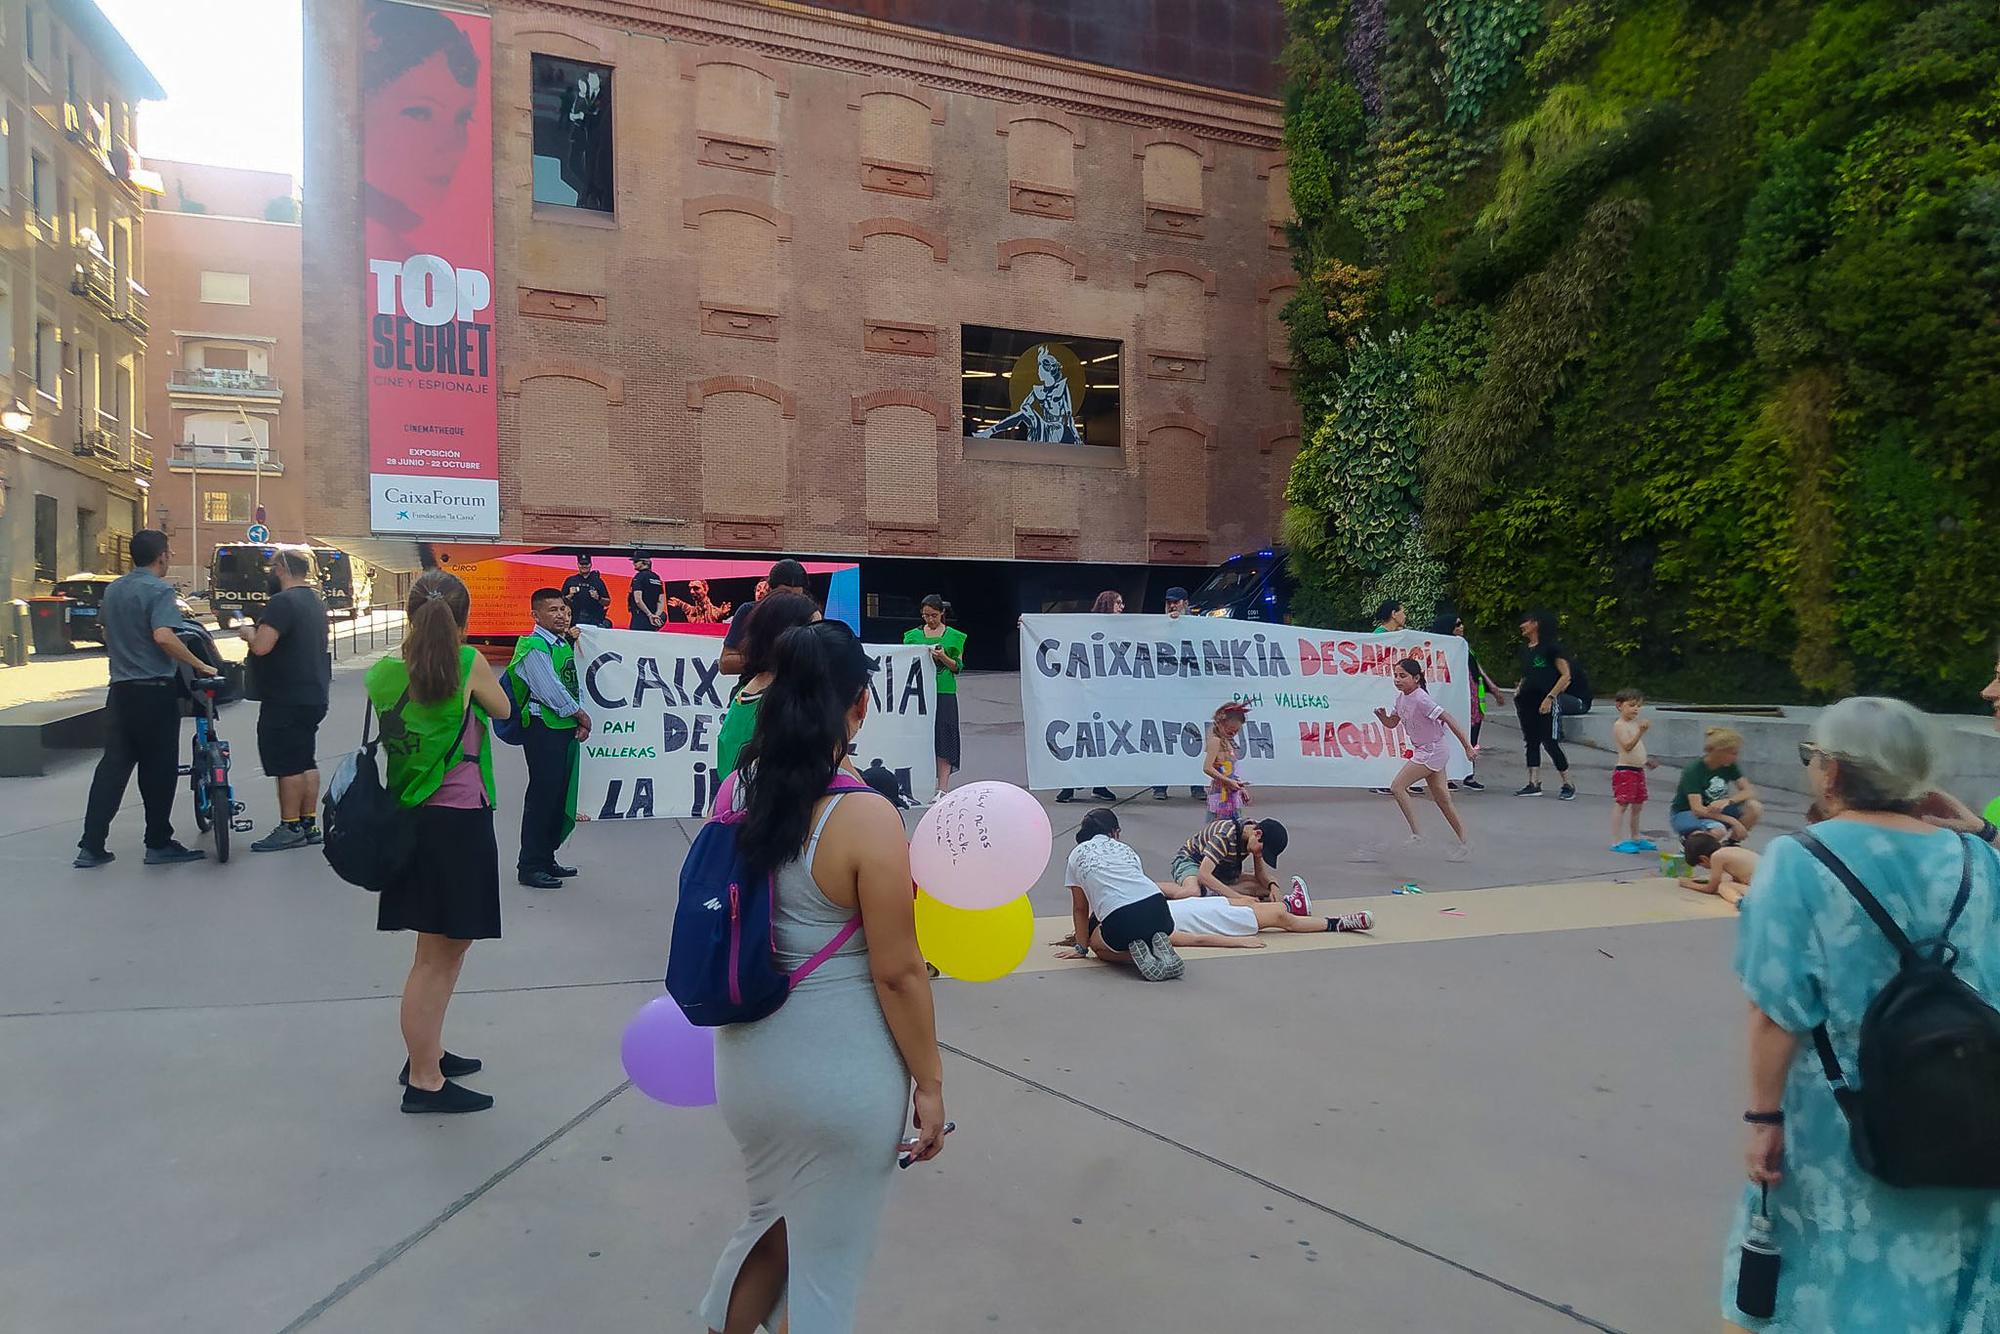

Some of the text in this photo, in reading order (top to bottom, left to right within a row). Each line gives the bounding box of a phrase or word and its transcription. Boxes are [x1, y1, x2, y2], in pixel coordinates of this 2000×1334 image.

[369, 254, 491, 327] TOP
[373, 315, 491, 377] SECRET
[374, 376, 488, 394] CINE Y ESPIONAJE
[409, 448, 461, 458] EXPOSICIÓN
[398, 458, 425, 466] JUNIO
[431, 460, 440, 468] 22
[442, 460, 481, 469] OCTUBRE
[384, 487, 486, 507] CaixaForum
[452, 564, 478, 572] CIRCO
[1233, 691, 1330, 709] PAH VALLEKAS
[602, 720, 636, 734] PAH
[1045, 711, 1275, 761] CAIXAFOUM
[586, 745, 657, 759] VALLEKAS
[598, 777, 655, 820] LA
